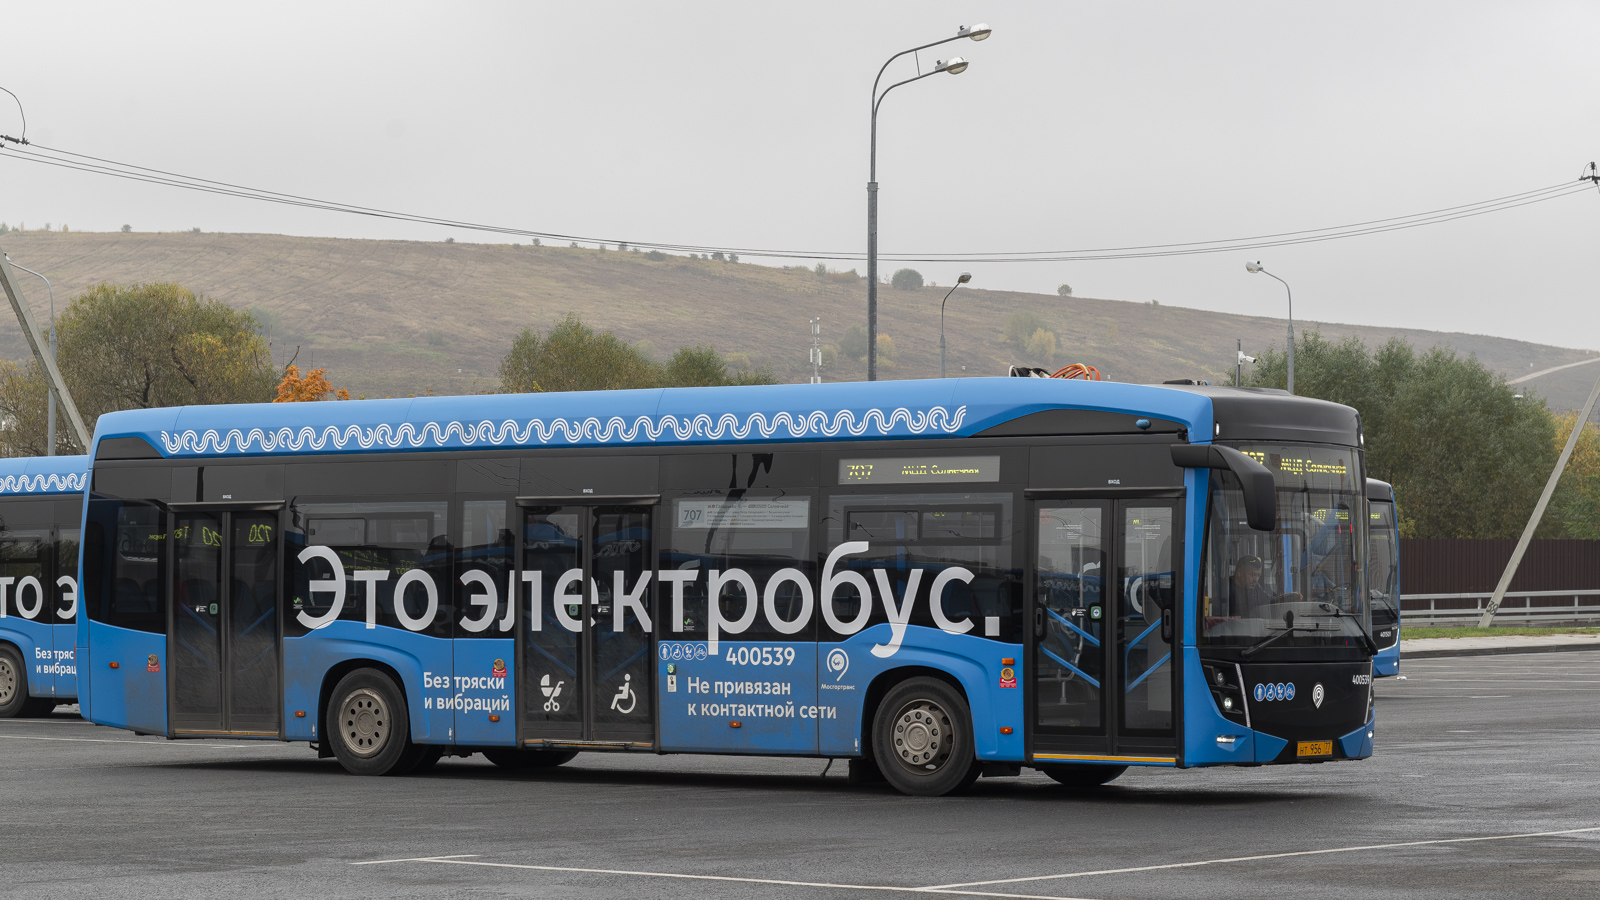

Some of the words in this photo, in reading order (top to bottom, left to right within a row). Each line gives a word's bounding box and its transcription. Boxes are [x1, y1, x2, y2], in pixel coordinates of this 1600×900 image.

[847, 465, 873, 480] 707
[683, 509, 702, 521] 707
[296, 545, 438, 631] Это
[459, 541, 1000, 659] электробус.
[35, 647, 52, 659] Без
[53, 649, 74, 662] тряс
[725, 646, 796, 666] 400539
[36, 664, 42, 674] и
[423, 672, 450, 689] Без
[453, 676, 505, 693] тряски
[687, 676, 710, 694] Не
[714, 681, 791, 698] привязан
[820, 683, 856, 691] Мосгортранс
[1352, 674, 1370, 685] 400539
[424, 697, 433, 710] и
[436, 693, 510, 714] вибраций
[687, 703, 697, 716] к
[701, 701, 795, 718] контактной
[799, 705, 837, 719] сети
[1310, 743, 1322, 755] 956
